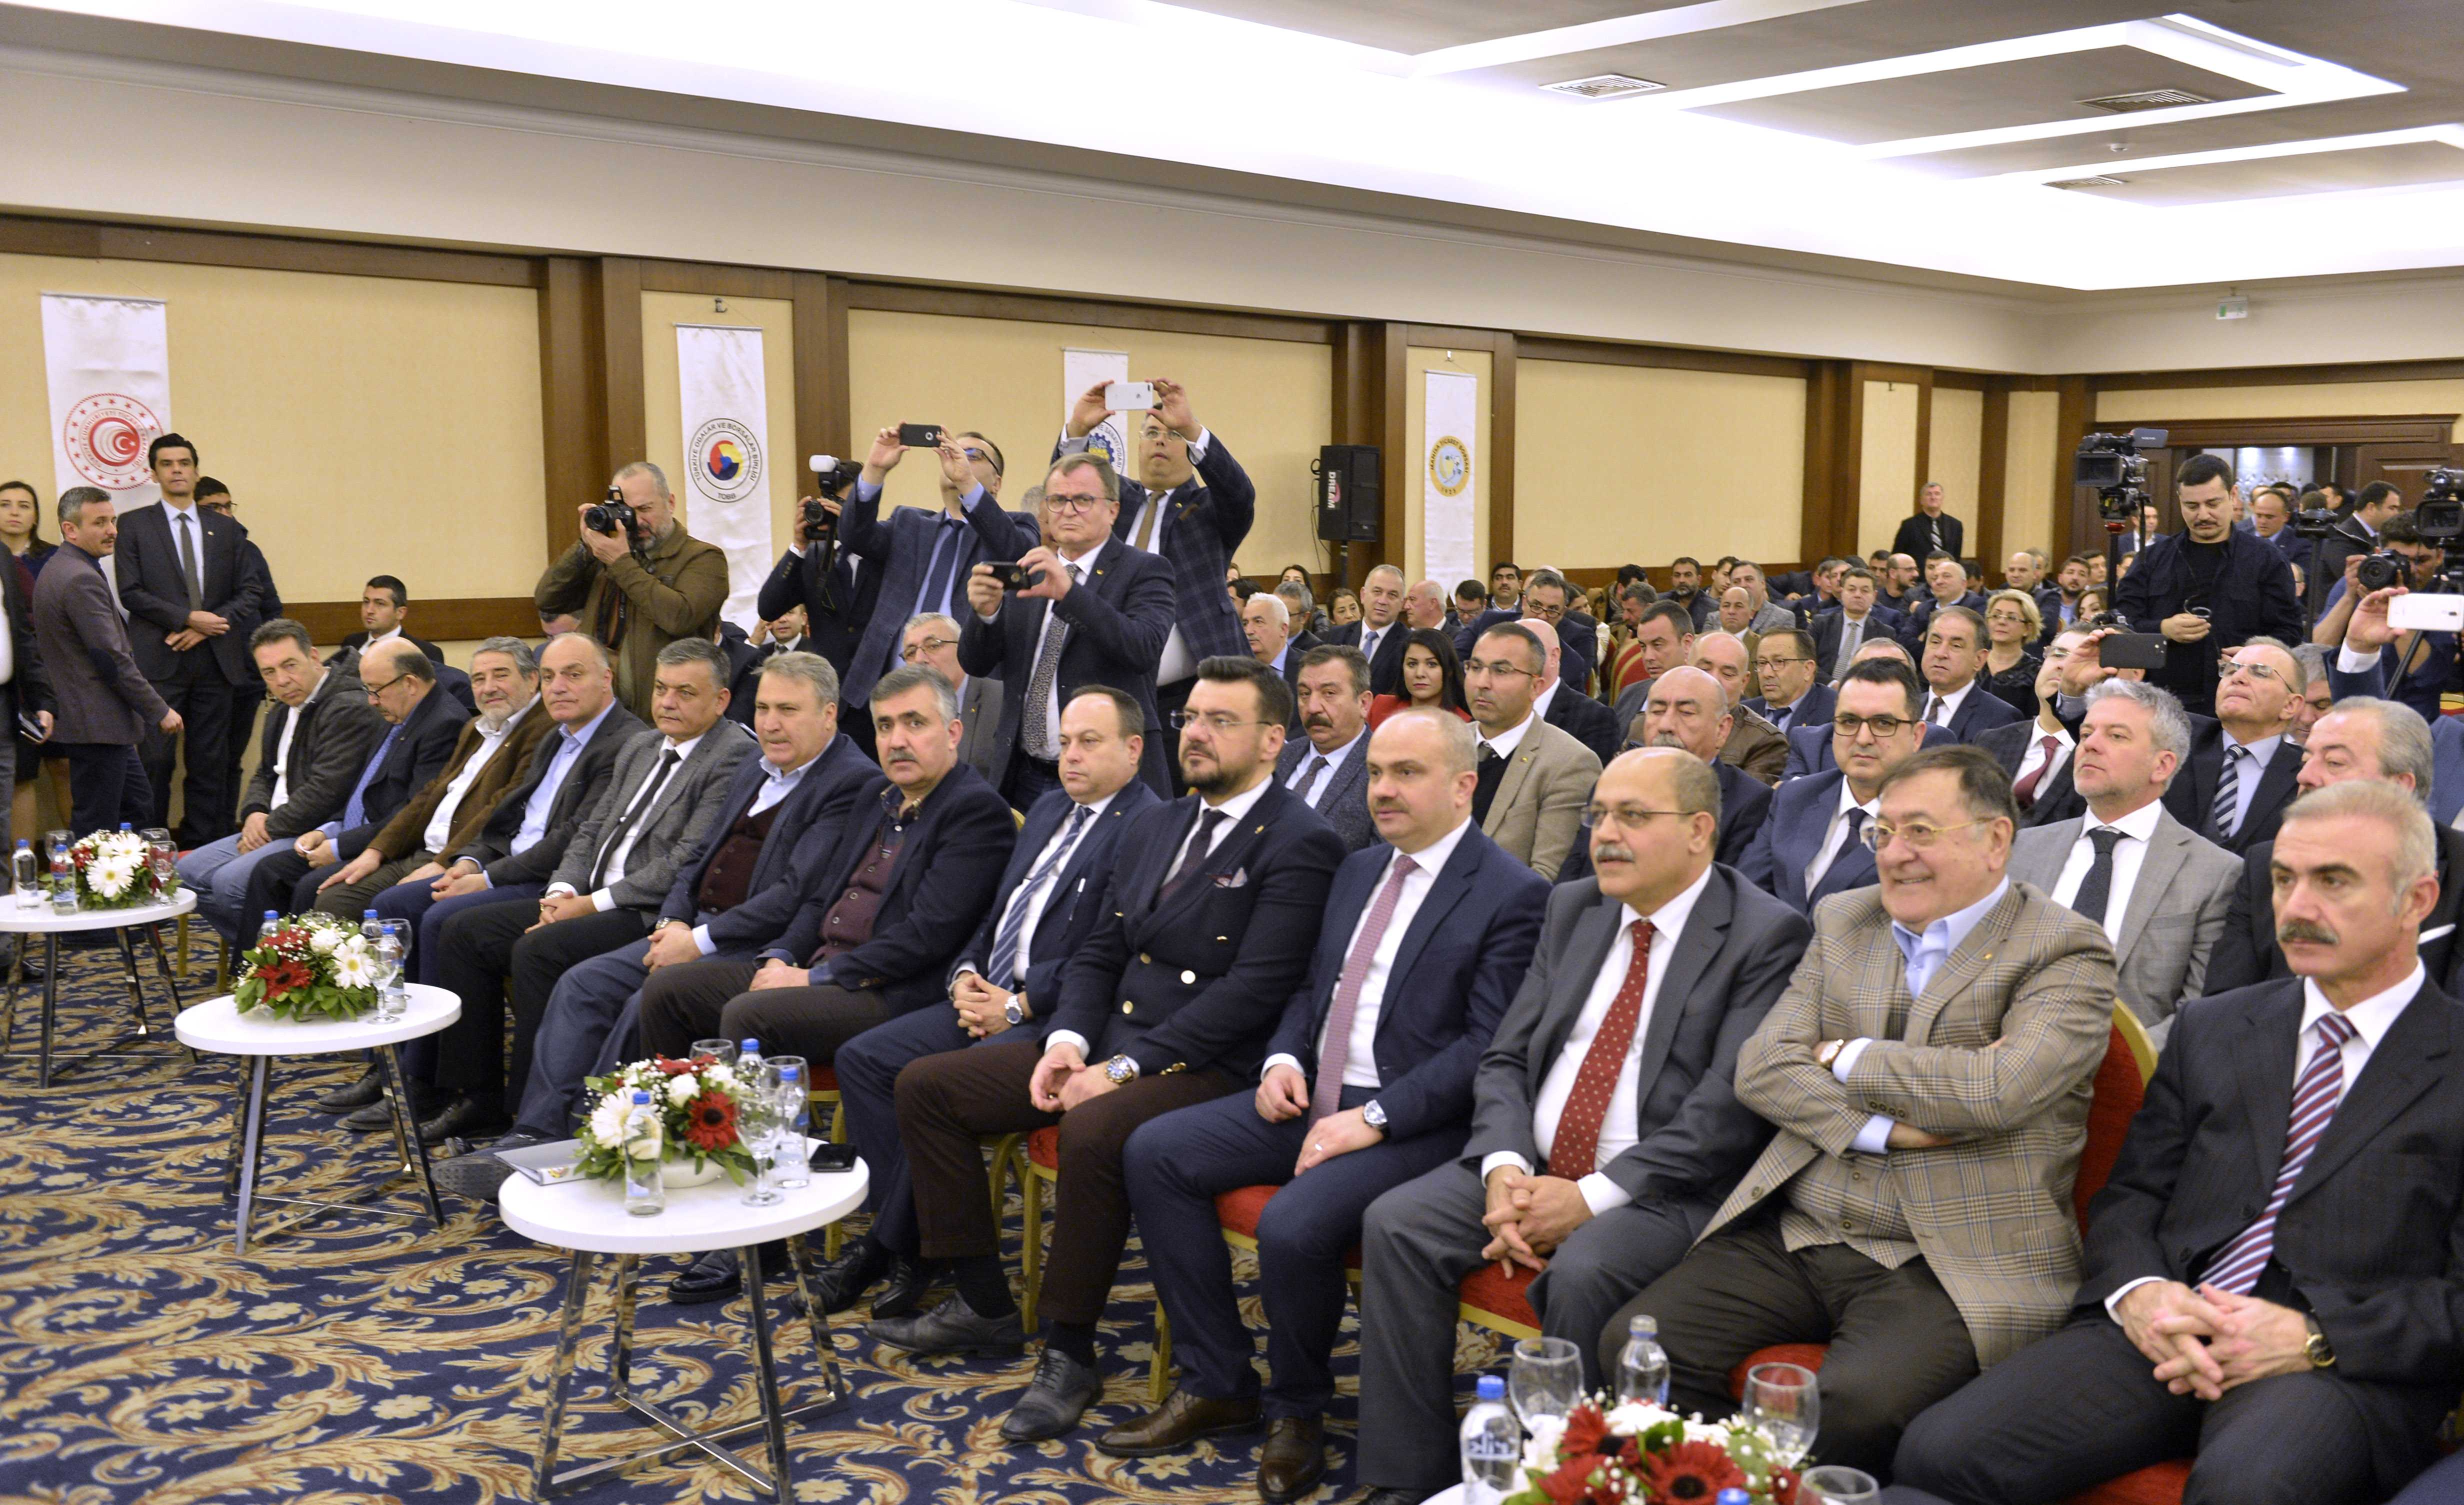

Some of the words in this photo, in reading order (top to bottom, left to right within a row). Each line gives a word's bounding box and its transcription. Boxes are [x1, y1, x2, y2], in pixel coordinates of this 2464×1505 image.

[696, 424, 716, 448] ODALAR
[728, 423, 756, 452] BORSALAR
[1328, 472, 1336, 508] DREAM
